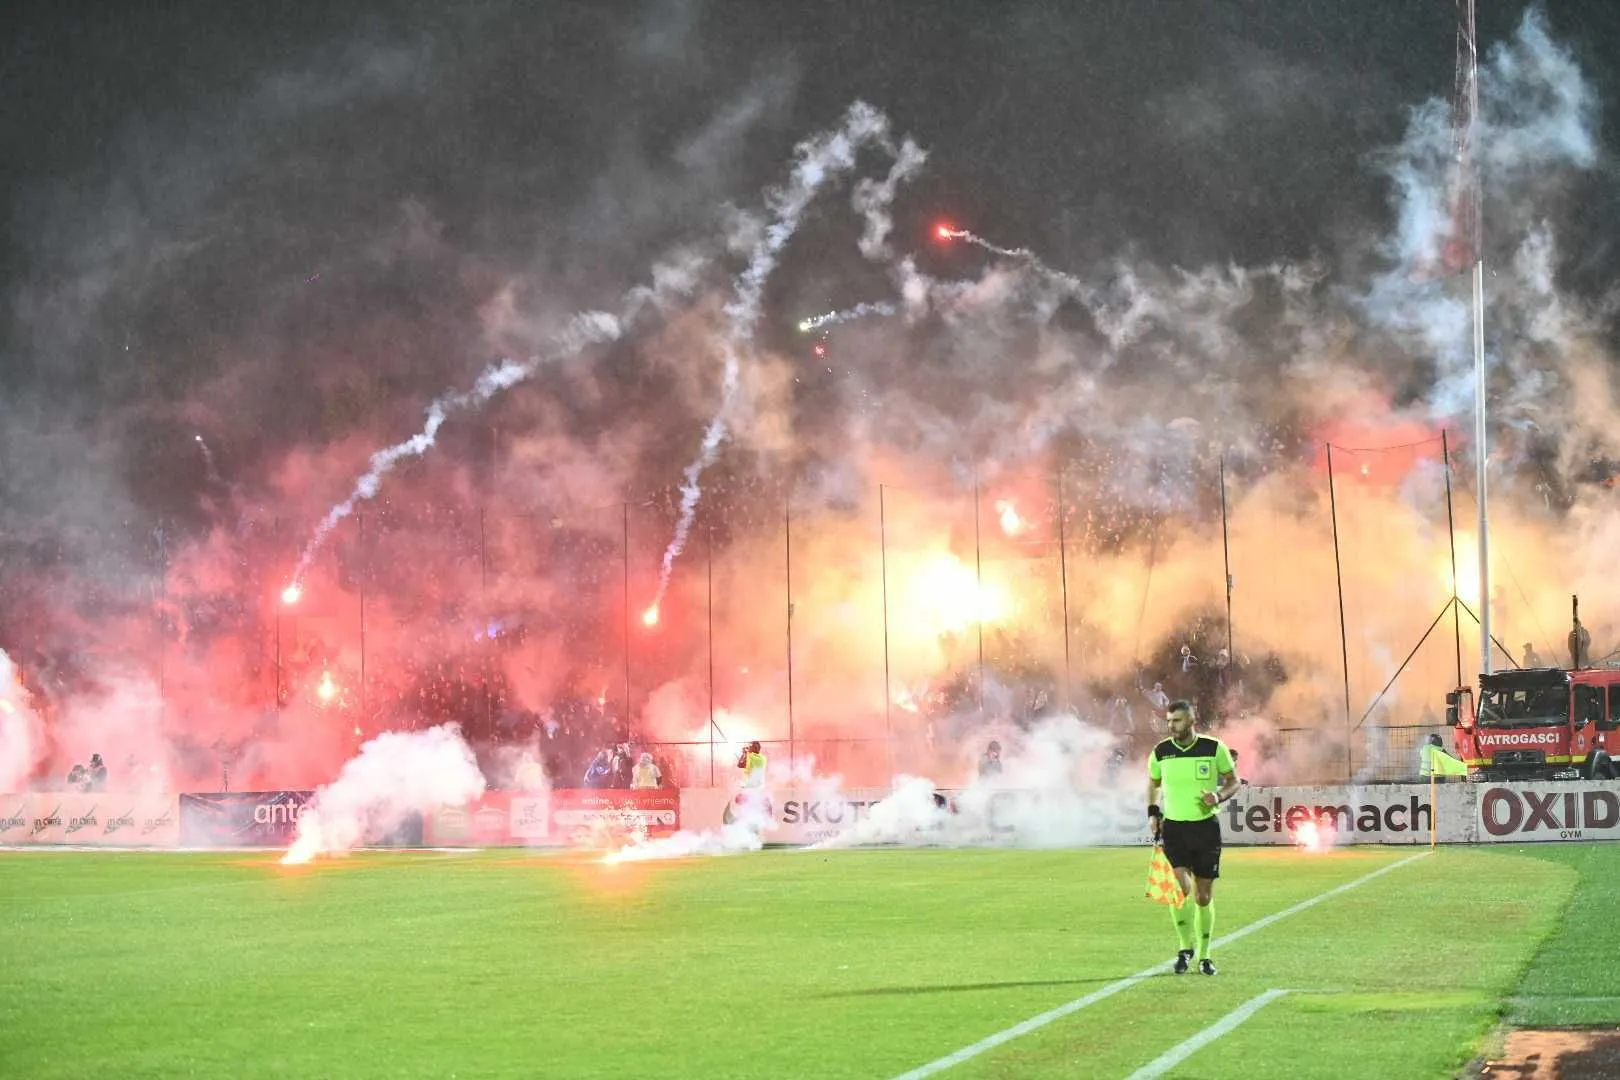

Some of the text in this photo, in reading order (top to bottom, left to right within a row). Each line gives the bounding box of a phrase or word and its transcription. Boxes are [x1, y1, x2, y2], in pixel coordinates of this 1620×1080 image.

[1478, 733, 1560, 746] VATROGASCI
[782, 800, 881, 824] SKUT
[1226, 796, 1433, 833] telemach
[1481, 787, 1620, 836] OXID
[1560, 830, 1582, 839] GYM
